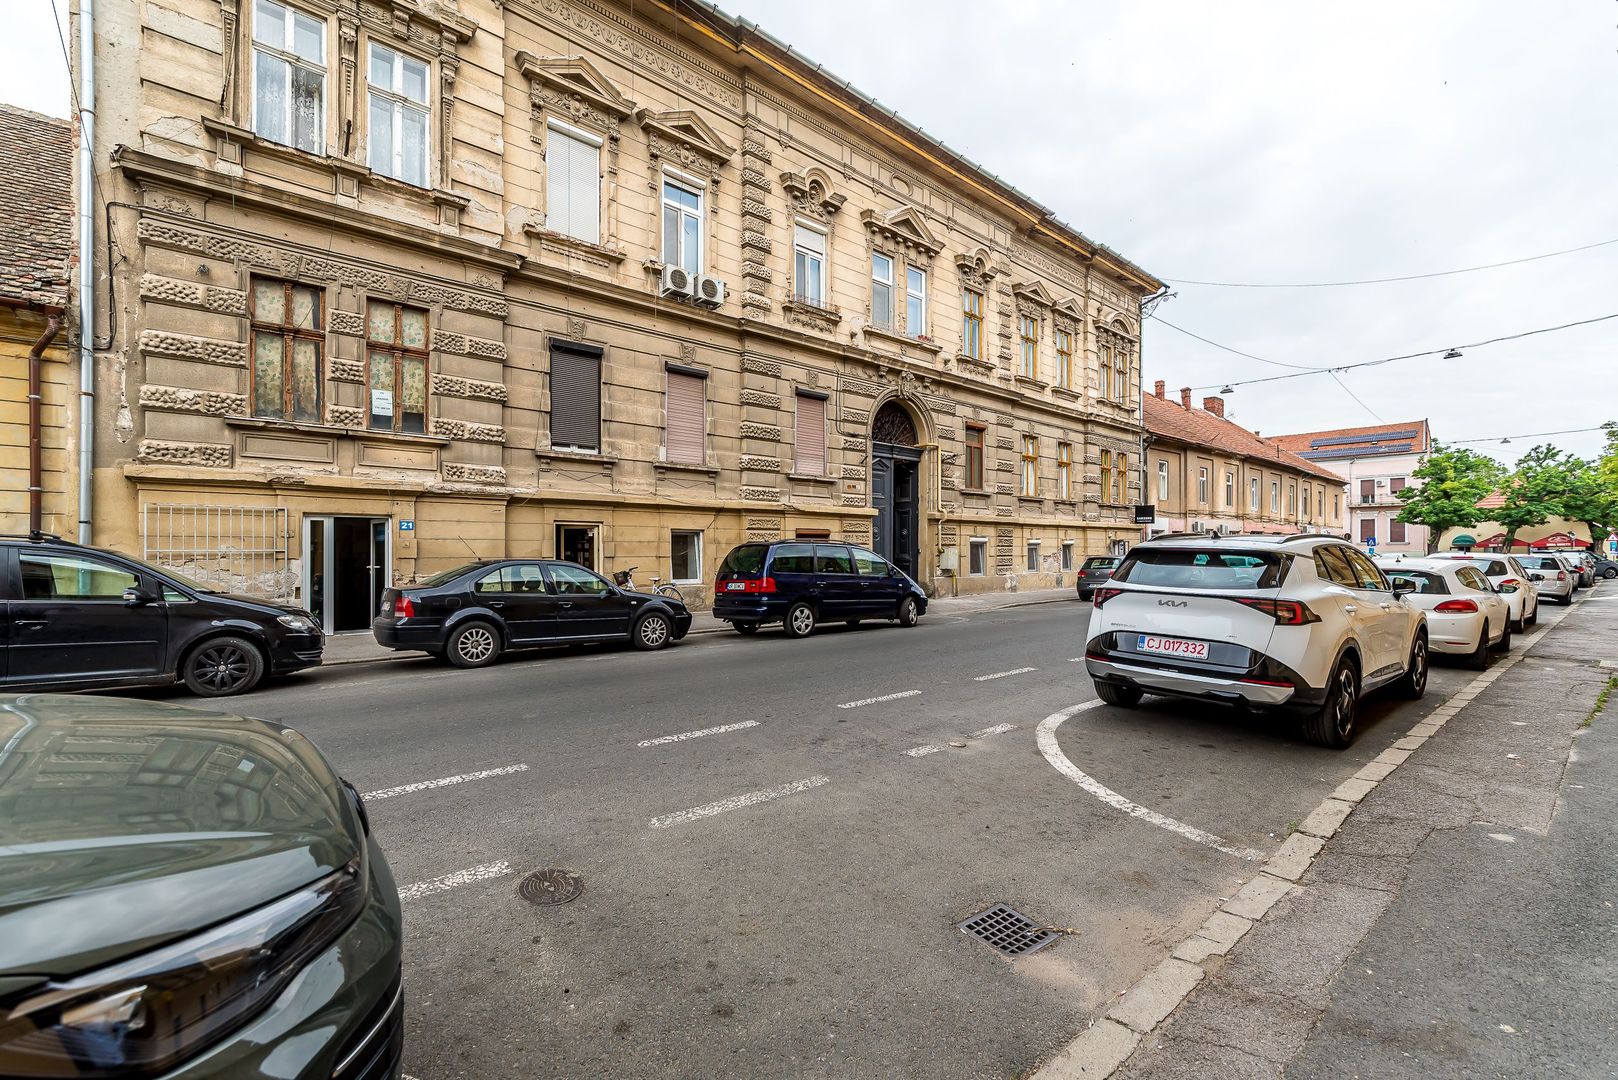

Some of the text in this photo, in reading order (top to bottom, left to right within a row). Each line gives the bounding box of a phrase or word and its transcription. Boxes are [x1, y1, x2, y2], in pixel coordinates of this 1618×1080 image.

[1158, 600, 1188, 608] KIA
[1146, 638, 1162, 650] CJ
[1163, 639, 1205, 655] 017332
